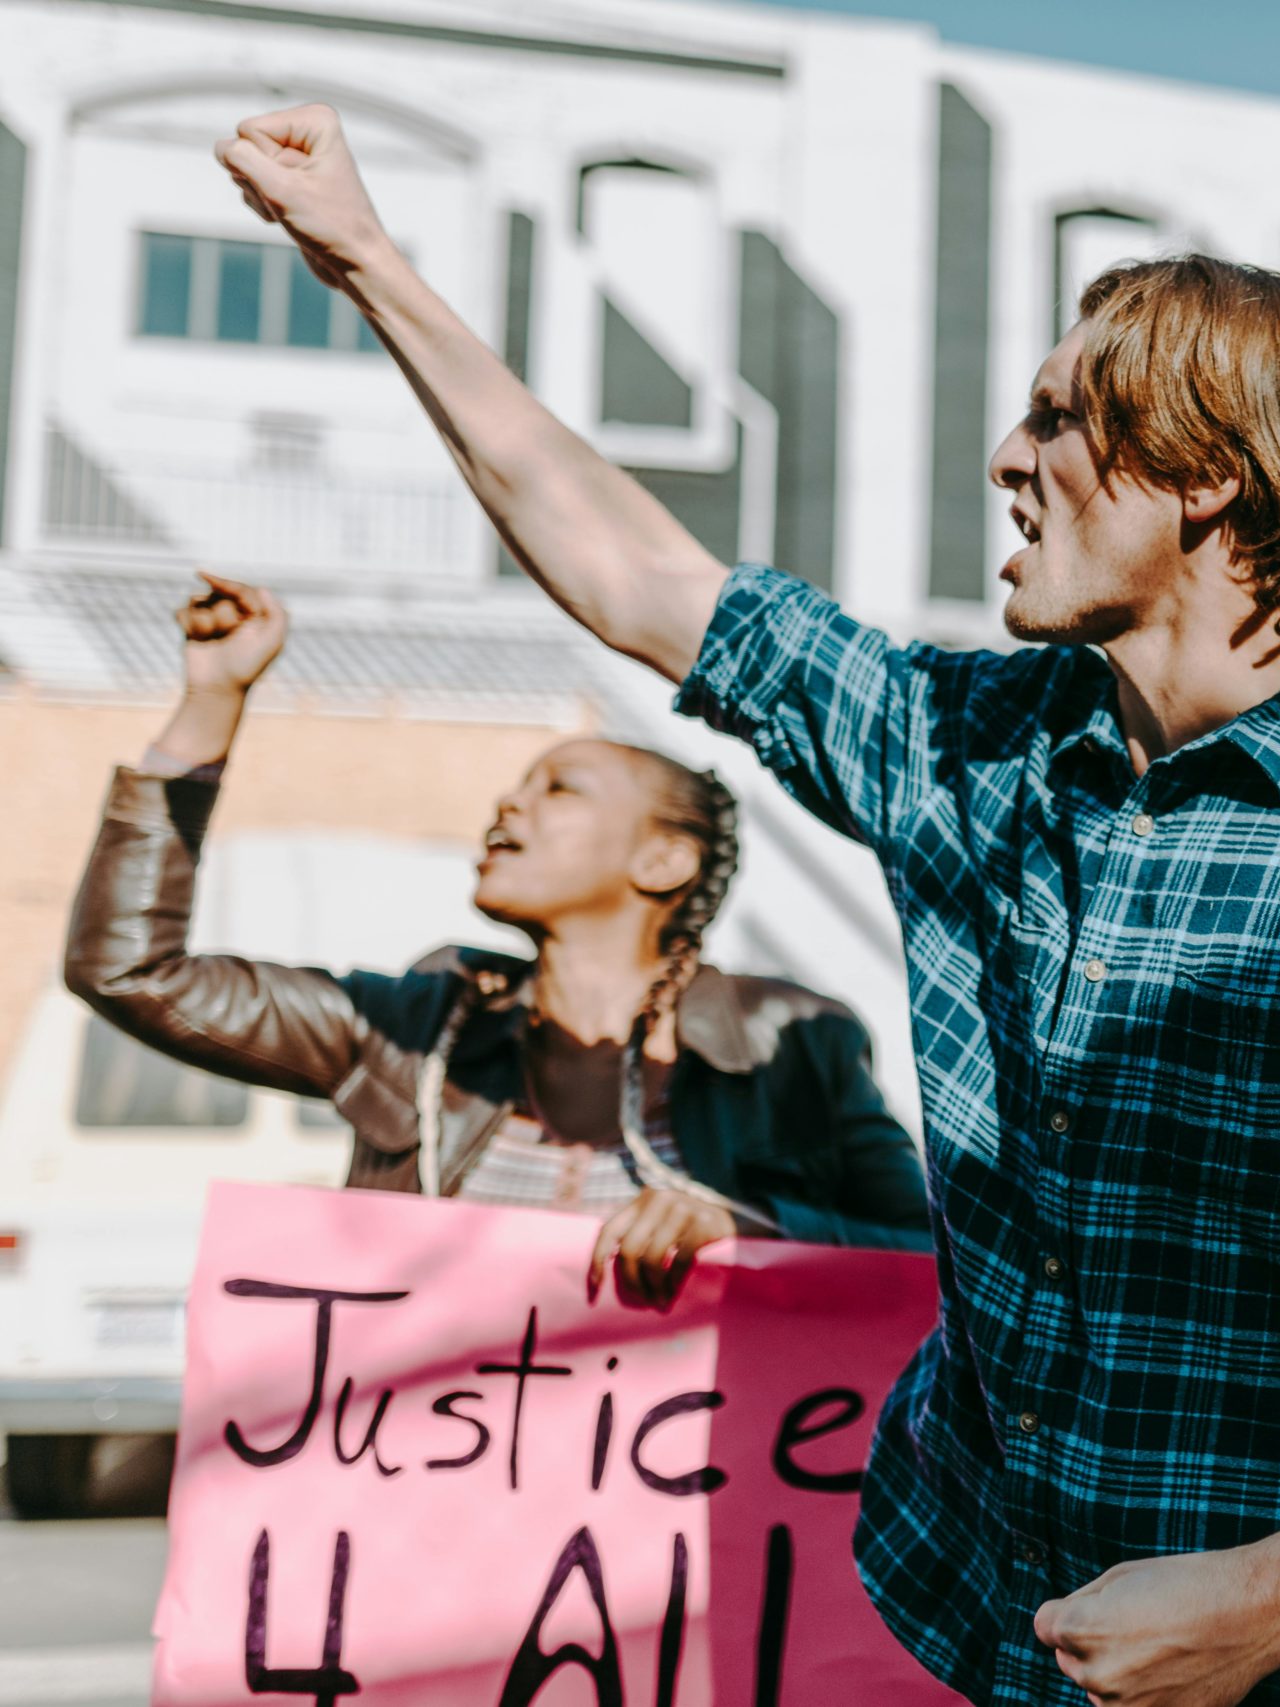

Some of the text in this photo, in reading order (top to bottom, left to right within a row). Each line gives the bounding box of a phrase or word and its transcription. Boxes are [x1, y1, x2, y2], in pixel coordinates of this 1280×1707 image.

[222, 1278, 866, 1497] Justice
[245, 1523, 793, 1707] 4 All
